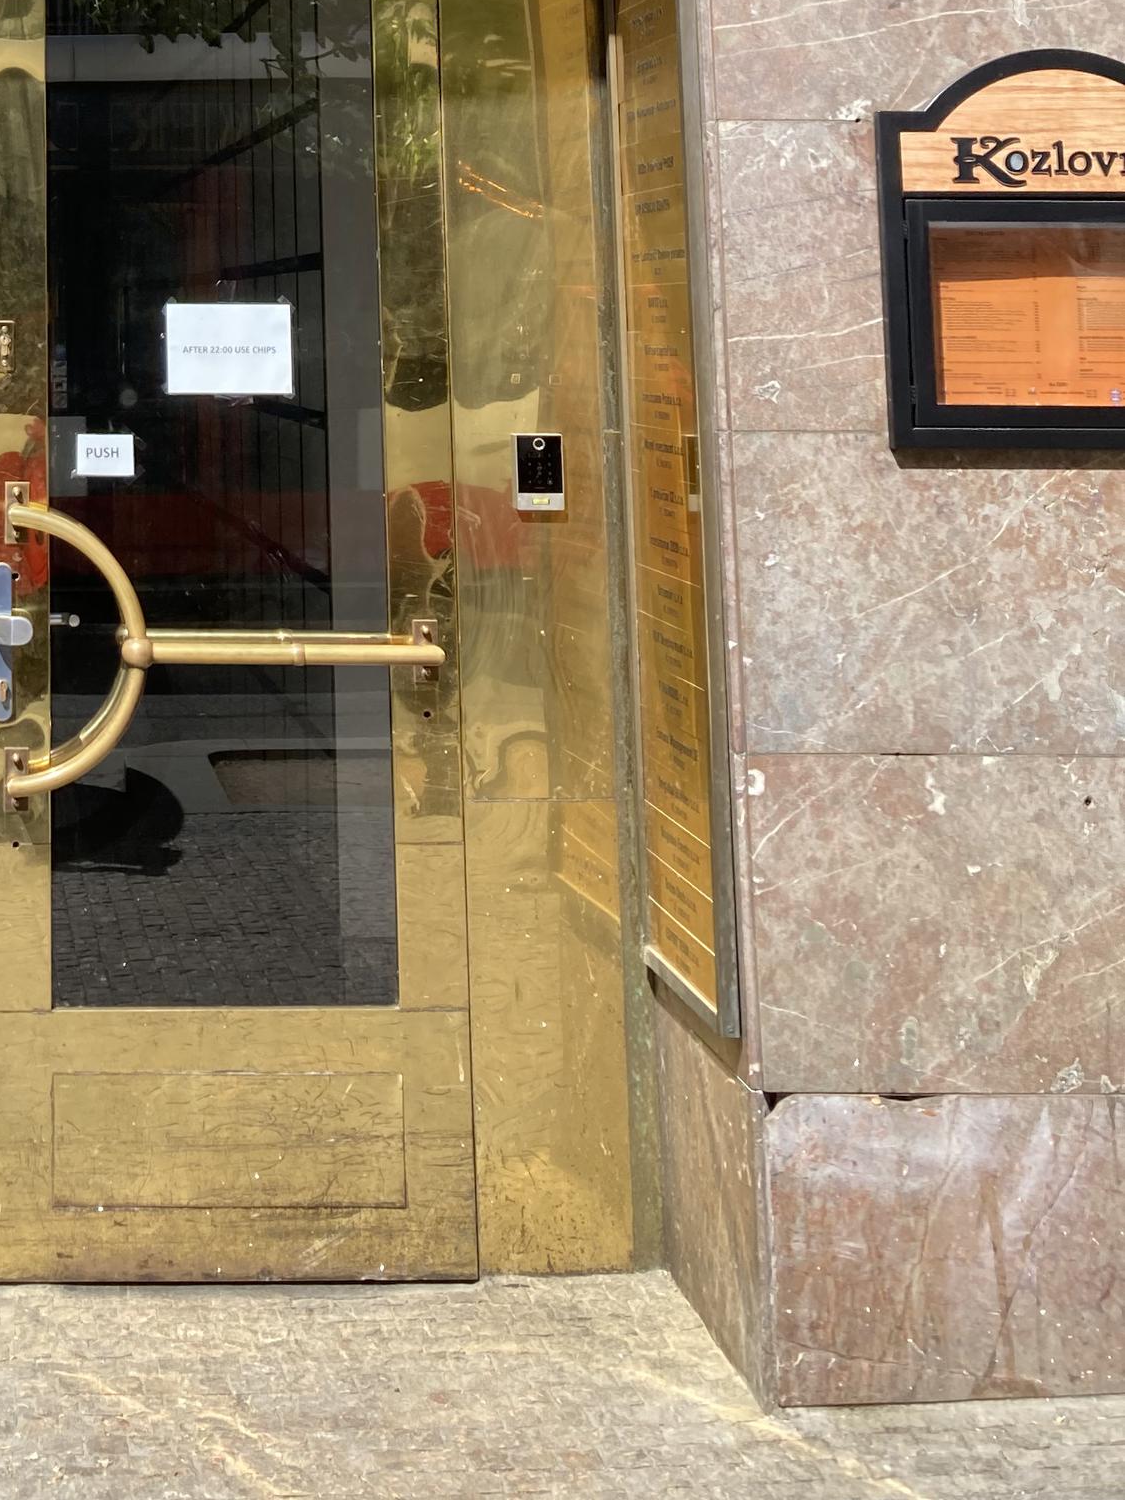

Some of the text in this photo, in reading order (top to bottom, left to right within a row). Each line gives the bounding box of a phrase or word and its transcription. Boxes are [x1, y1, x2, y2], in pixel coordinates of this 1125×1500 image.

[950, 136, 1125, 188] Kozlov
[182, 345, 277, 355] AFTER 22:00 USE CHIPS
[85, 447, 120, 459] PUSH
